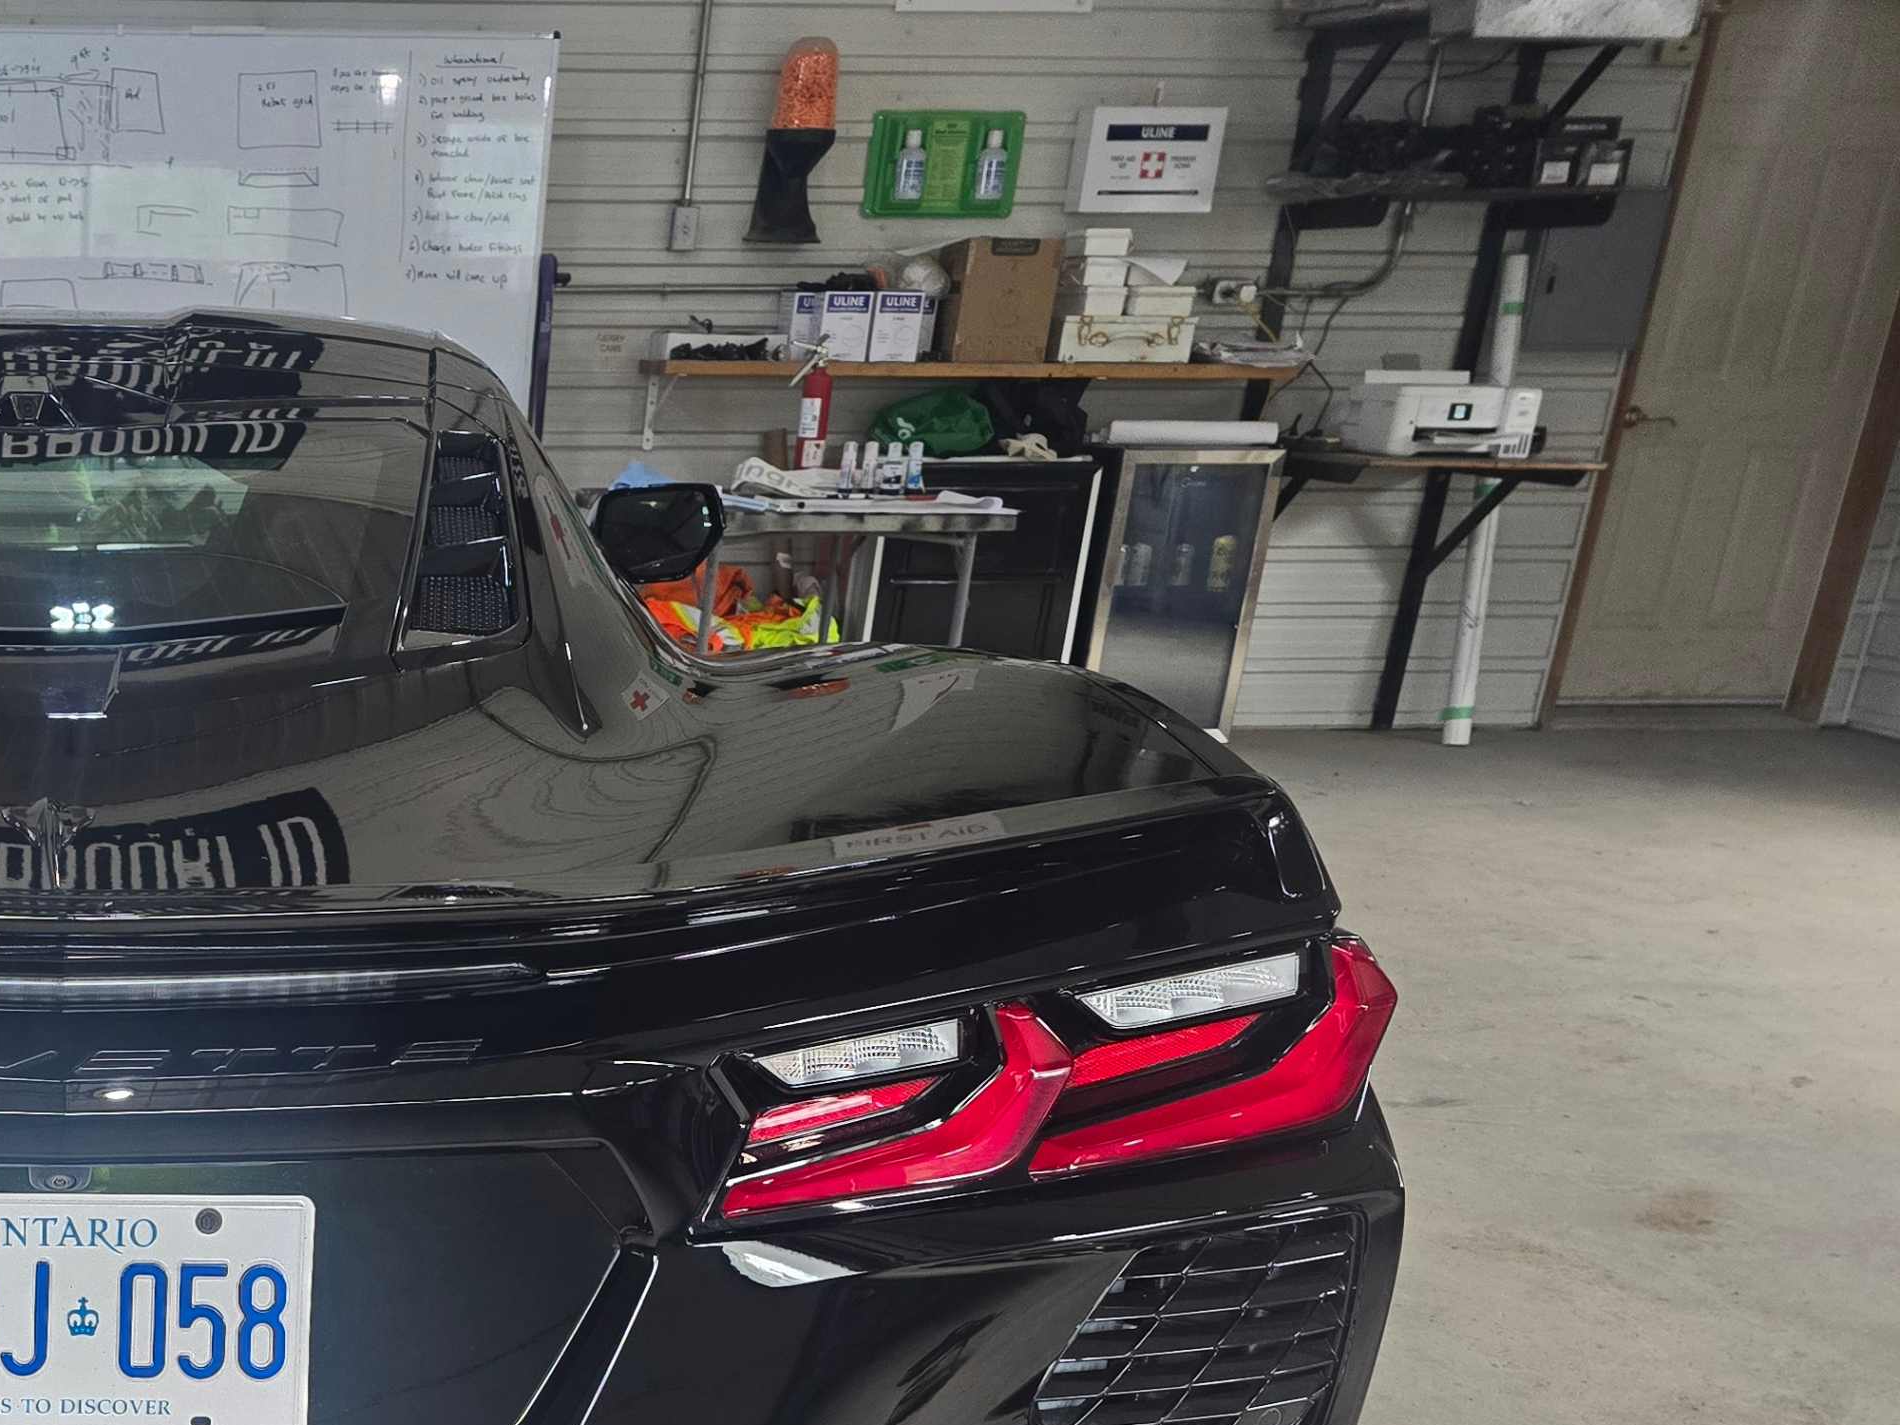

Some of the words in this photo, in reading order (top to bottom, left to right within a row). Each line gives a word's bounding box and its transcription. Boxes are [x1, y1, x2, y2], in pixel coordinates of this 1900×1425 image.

[1141, 126, 1176, 139] ULINE
[833, 296, 866, 306] ULINE
[886, 296, 917, 307] ULINE
[118, 1261, 288, 1380] 058
[22, 1398, 52, 1416] TO
[59, 1398, 172, 1417] DISCOVER
